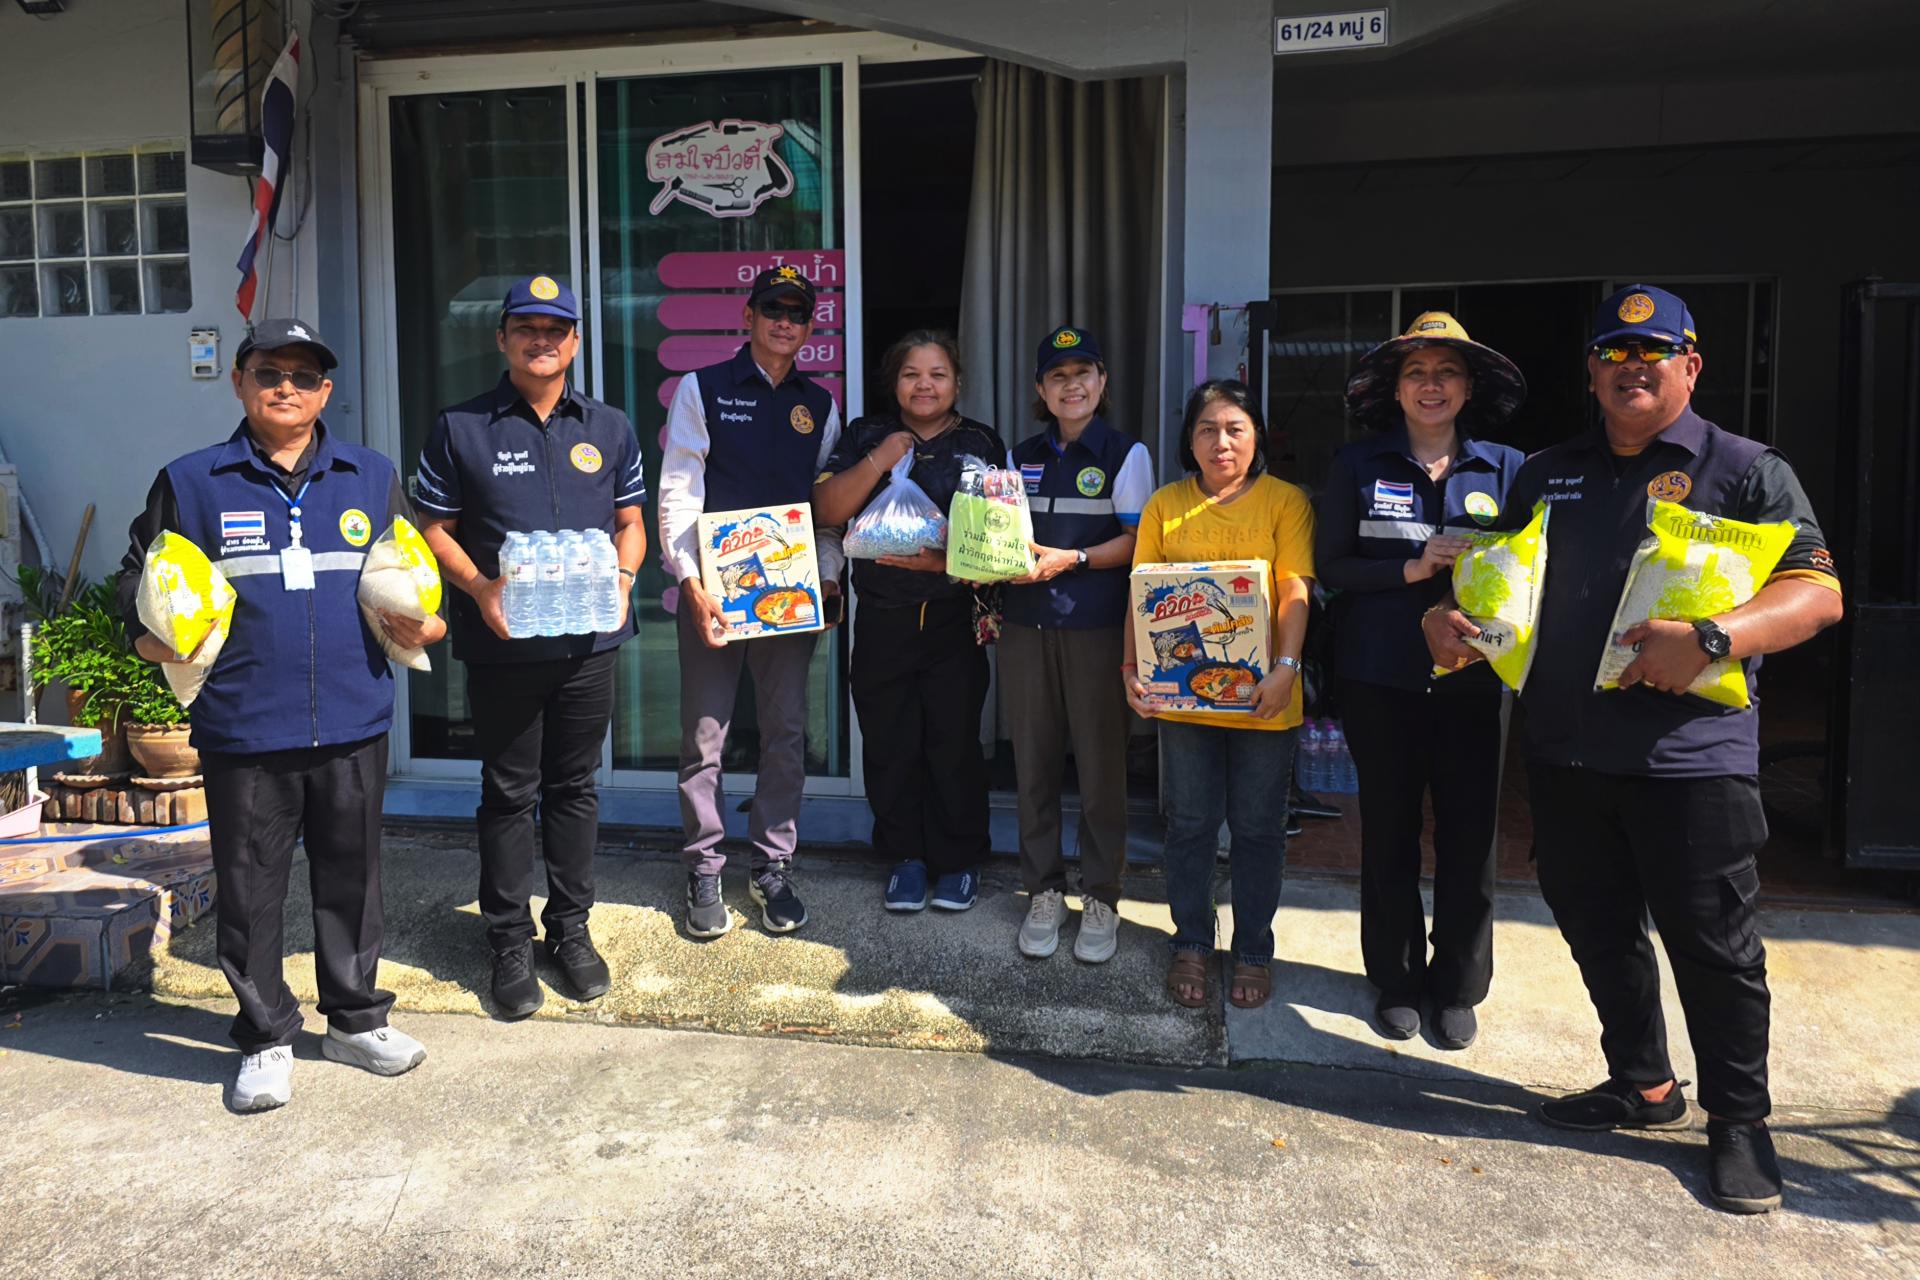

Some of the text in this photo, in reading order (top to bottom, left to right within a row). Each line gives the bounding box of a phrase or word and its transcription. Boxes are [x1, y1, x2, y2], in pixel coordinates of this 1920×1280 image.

[1281, 17, 1381, 41] 61/24 หมู่ 6
[656, 138, 765, 170] สมใจบิวตี้
[1472, 628, 1505, 647] ก่แจ้
